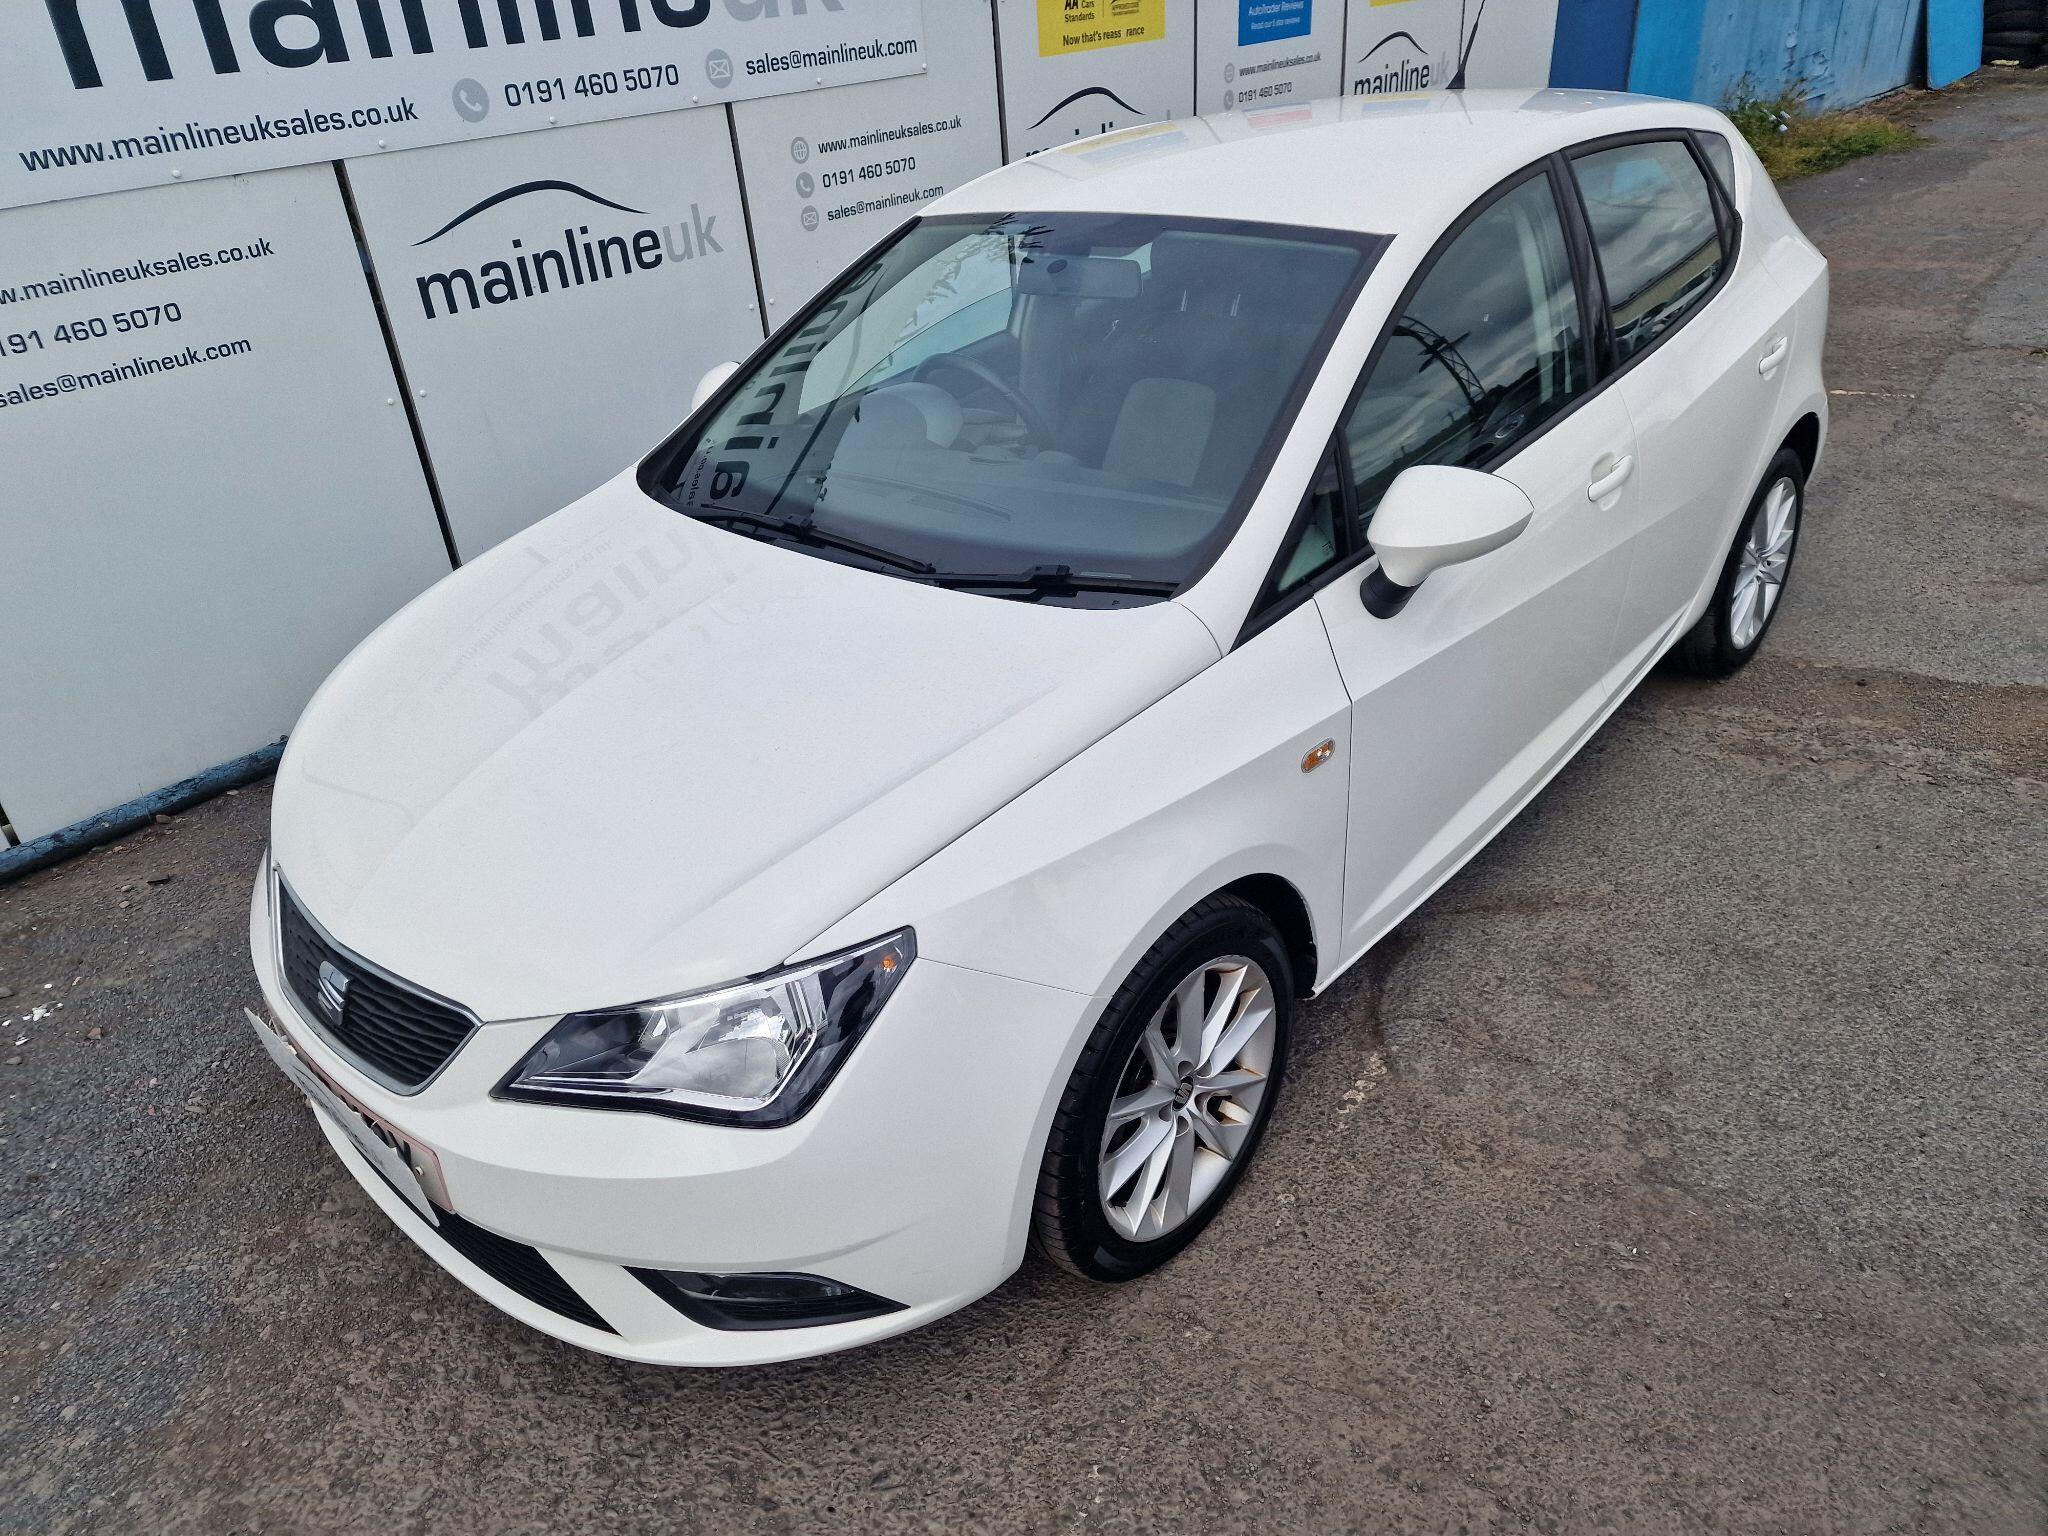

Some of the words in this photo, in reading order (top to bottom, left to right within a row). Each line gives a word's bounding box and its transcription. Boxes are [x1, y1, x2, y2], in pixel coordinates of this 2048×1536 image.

[1064, 12, 1095, 23] Standards
[1081, 1, 1095, 9] Cars
[1063, 35, 1080, 46] Now
[1082, 31, 1102, 43] that's
[19, 97, 419, 172] www.mainlineuksales.co.uk
[504, 77, 566, 107] 0191
[574, 71, 618, 98] 460
[624, 64, 680, 92] 5070
[745, 38, 918, 76] sales@mainlineuk.com
[1238, 88, 1257, 103] 0191
[1259, 85, 1273, 98] 460
[1273, 82, 1293, 95] 5070
[817, 115, 962, 154] www.mainlineuksales.co.uk
[822, 168, 855, 188] 0191
[858, 163, 883, 181] 460
[885, 156, 917, 176] 5070
[827, 184, 944, 221] sales@mainlineuk.com
[416, 203, 725, 320] mainlineuk
[53, 317, 108, 344] 460
[112, 302, 183, 333] 5070
